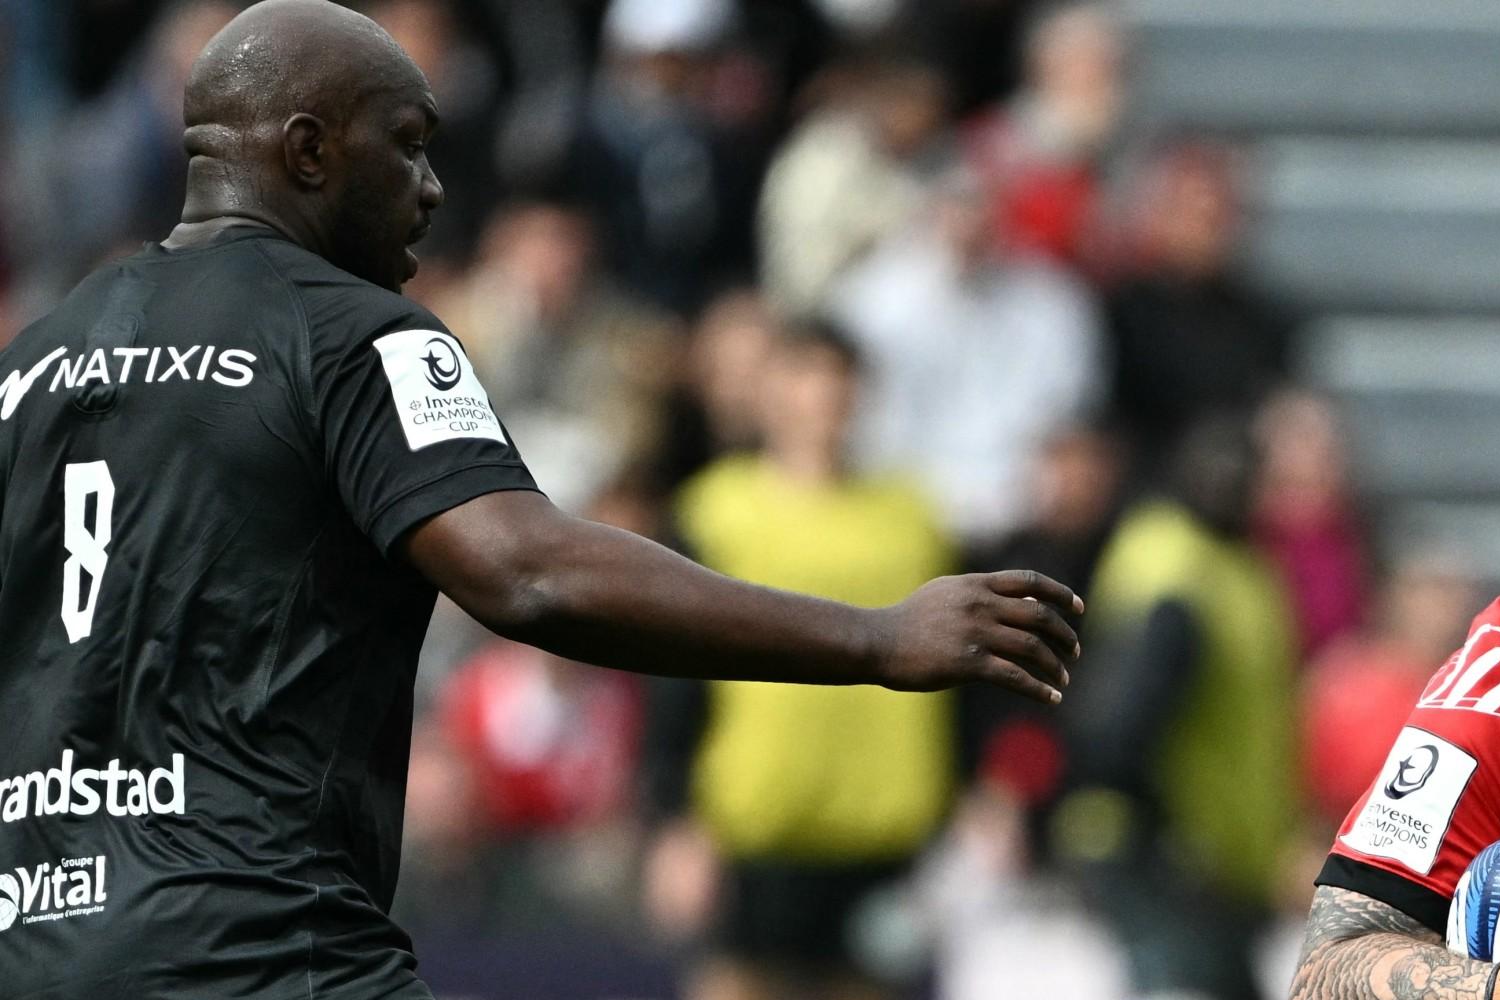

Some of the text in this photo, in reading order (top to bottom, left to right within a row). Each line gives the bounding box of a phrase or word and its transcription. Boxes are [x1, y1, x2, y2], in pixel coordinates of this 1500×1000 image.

[49, 345, 257, 387] NATIXIS
[413, 408, 497, 425] CHAMPION
[425, 396, 489, 410] Investe
[449, 421, 478, 431] CUP
[61, 459, 115, 644] 8
[0, 749, 185, 823] randstad
[61, 857, 93, 868] Groupe
[14, 855, 107, 914] Vital
